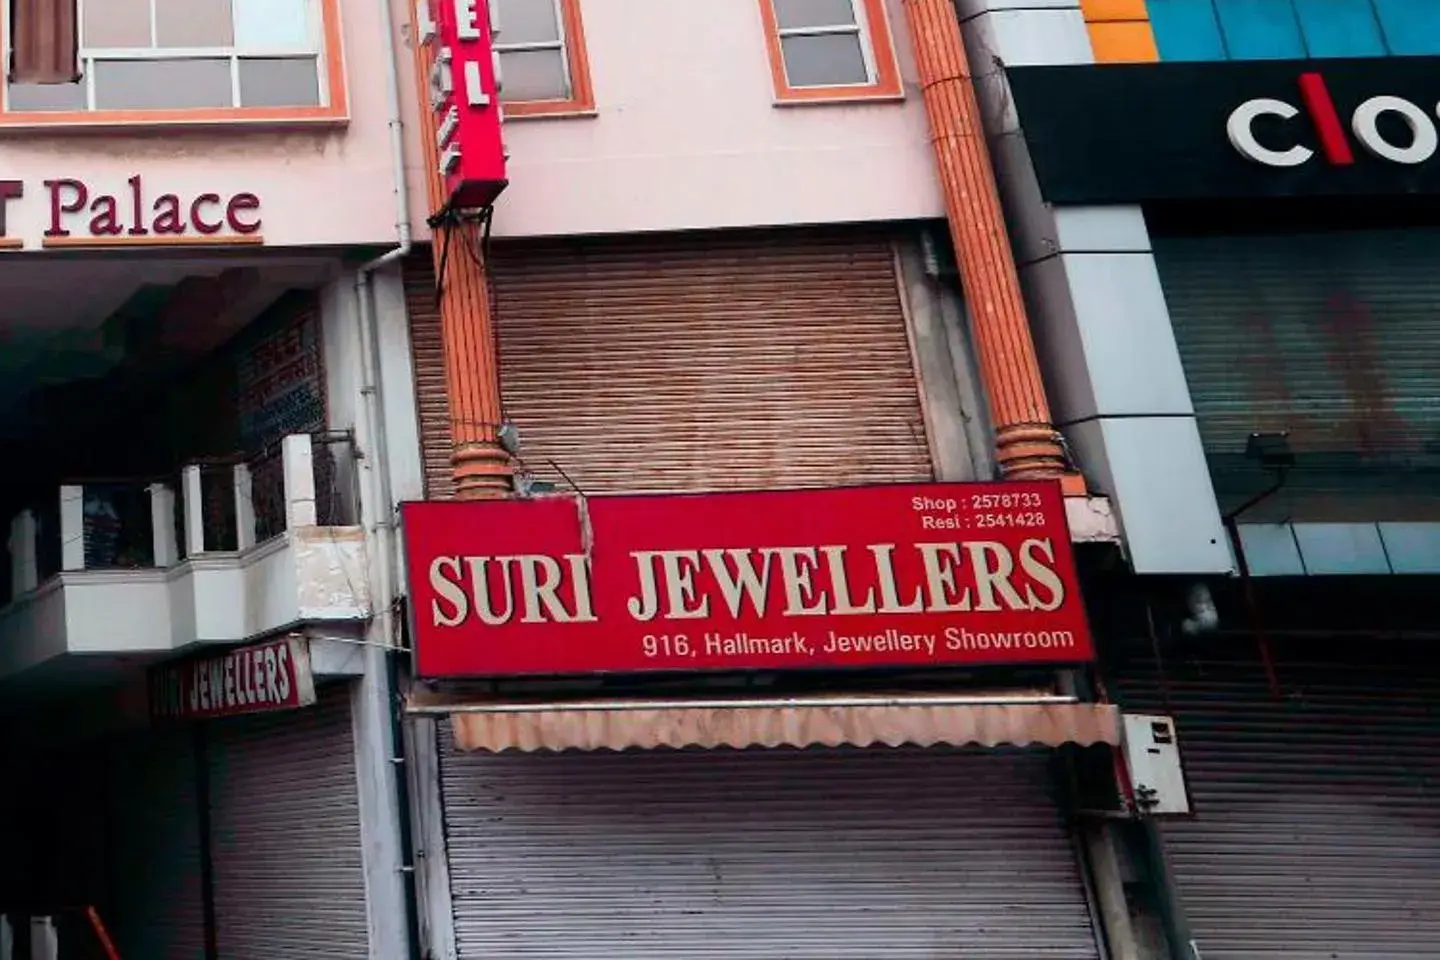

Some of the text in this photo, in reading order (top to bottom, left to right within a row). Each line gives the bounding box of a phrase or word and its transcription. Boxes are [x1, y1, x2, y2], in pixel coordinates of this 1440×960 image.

[43, 175, 263, 239] Palace
[911, 496, 958, 513] Shop
[970, 493, 1042, 509] 2578733
[921, 514, 961, 529] Resi
[975, 512, 1046, 529] 2541428
[428, 537, 1067, 628] SURI JEWELLERS
[641, 626, 1075, 659] 916, Hallmark, Jewellery Showroom
[190, 644, 290, 713] JEWELLERS
